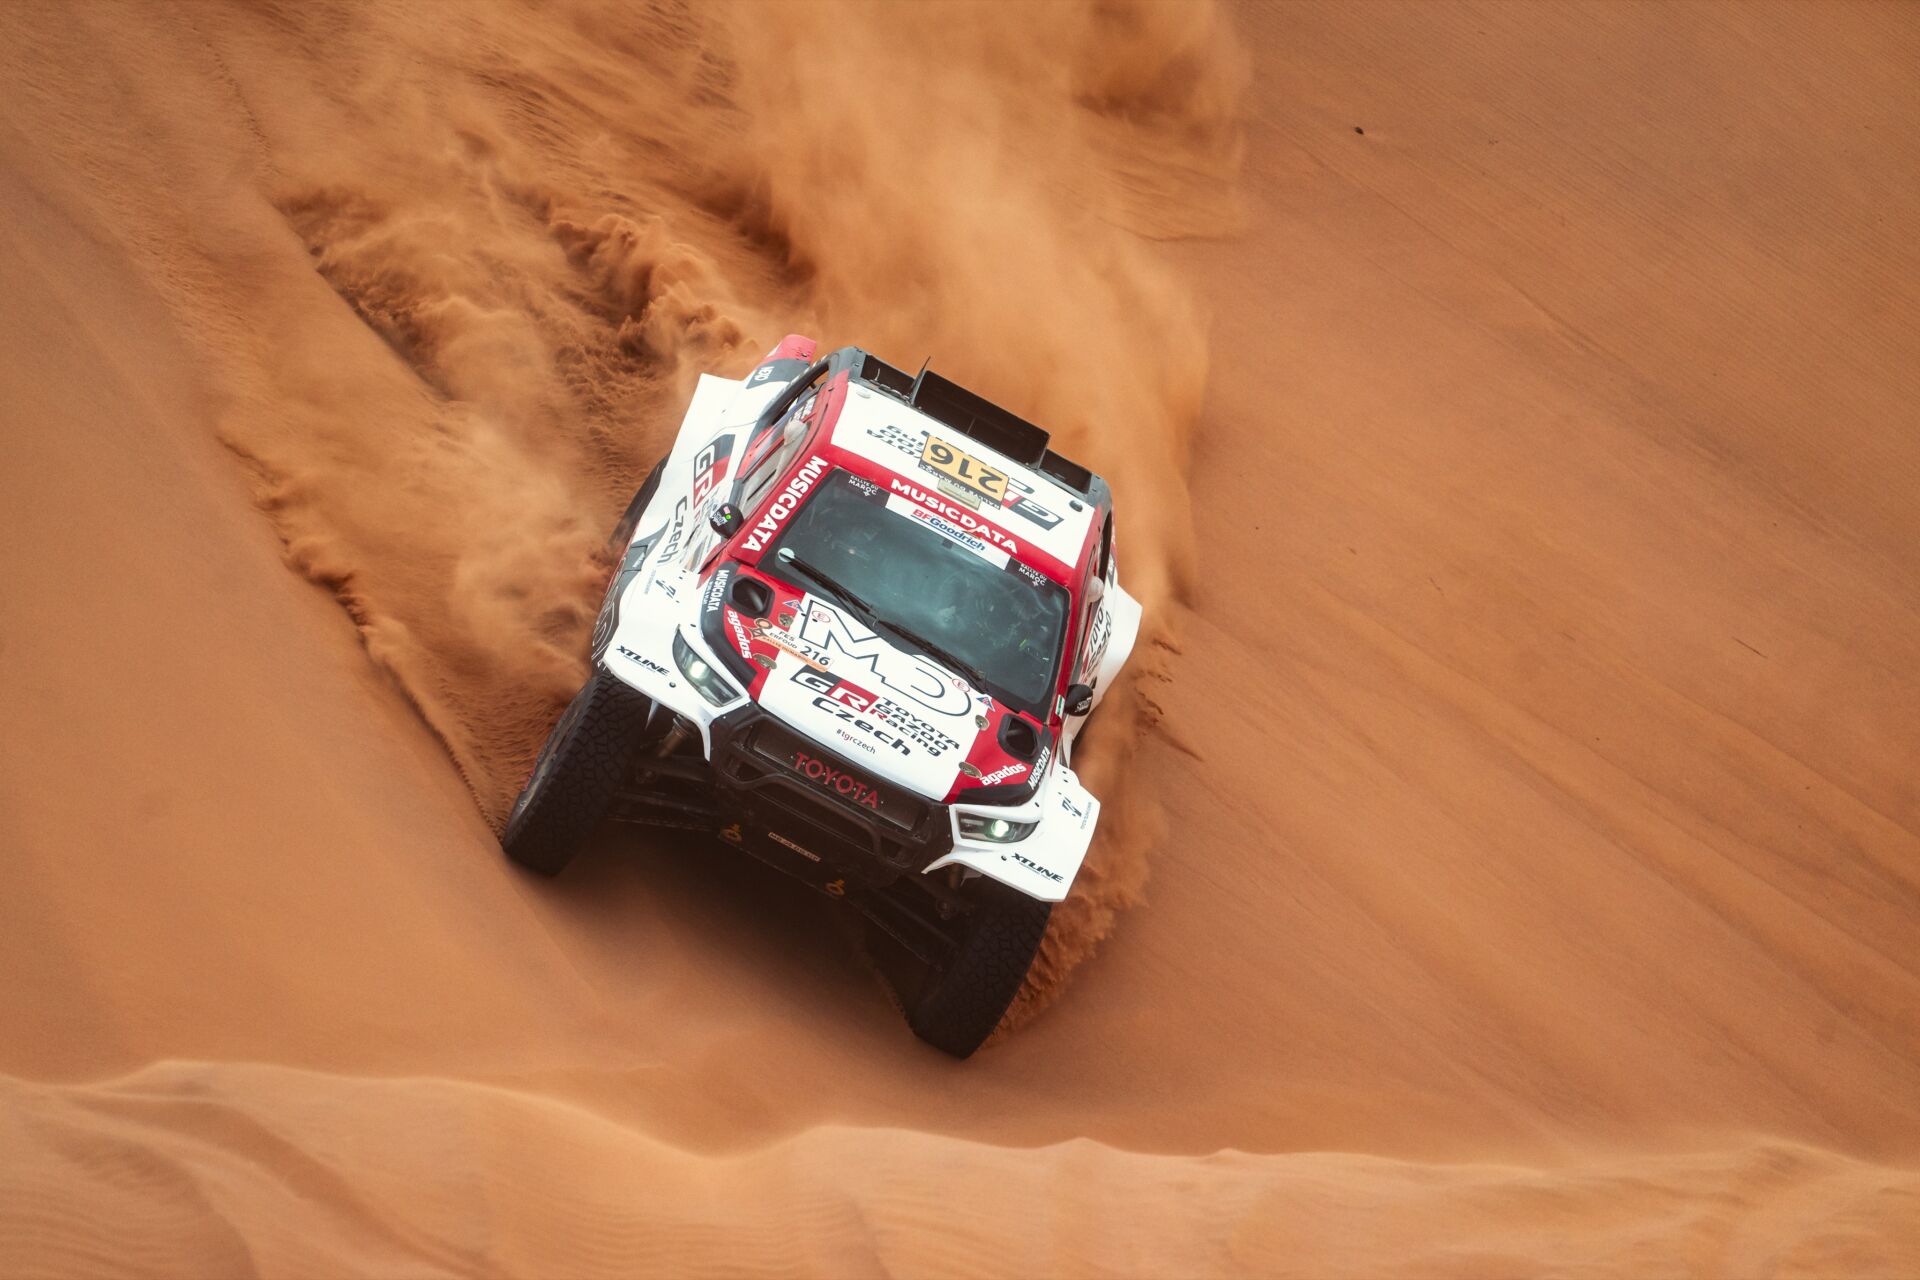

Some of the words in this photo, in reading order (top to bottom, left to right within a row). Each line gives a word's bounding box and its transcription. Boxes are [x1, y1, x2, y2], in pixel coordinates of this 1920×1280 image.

[848, 479, 877, 495] MAROC
[850, 475, 869, 487] RALLYE
[929, 443, 1003, 494] 216
[741, 455, 828, 552] MUSICDATA
[891, 479, 1018, 554] MUSICDATA
[657, 496, 687, 563] Czech
[912, 508, 986, 551] BFGoodrich
[707, 569, 730, 612] MUSICDATA
[1019, 568, 1045, 586] MAROC
[727, 610, 752, 659] agados
[779, 631, 795, 641] FES
[800, 646, 831, 666] 216
[616, 645, 670, 675] XTLINE
[793, 668, 874, 713] GR
[812, 696, 911, 756] Czech
[836, 728, 876, 754] #tgrczech
[869, 708, 941, 757] Racing
[875, 703, 948, 751] GAZOO
[881, 696, 960, 750] TOYOTA
[795, 752, 878, 809] TOYOTA
[980, 763, 1027, 785] agados
[1027, 746, 1050, 790] MUSICDATA
[1011, 852, 1064, 883] XTLINE
